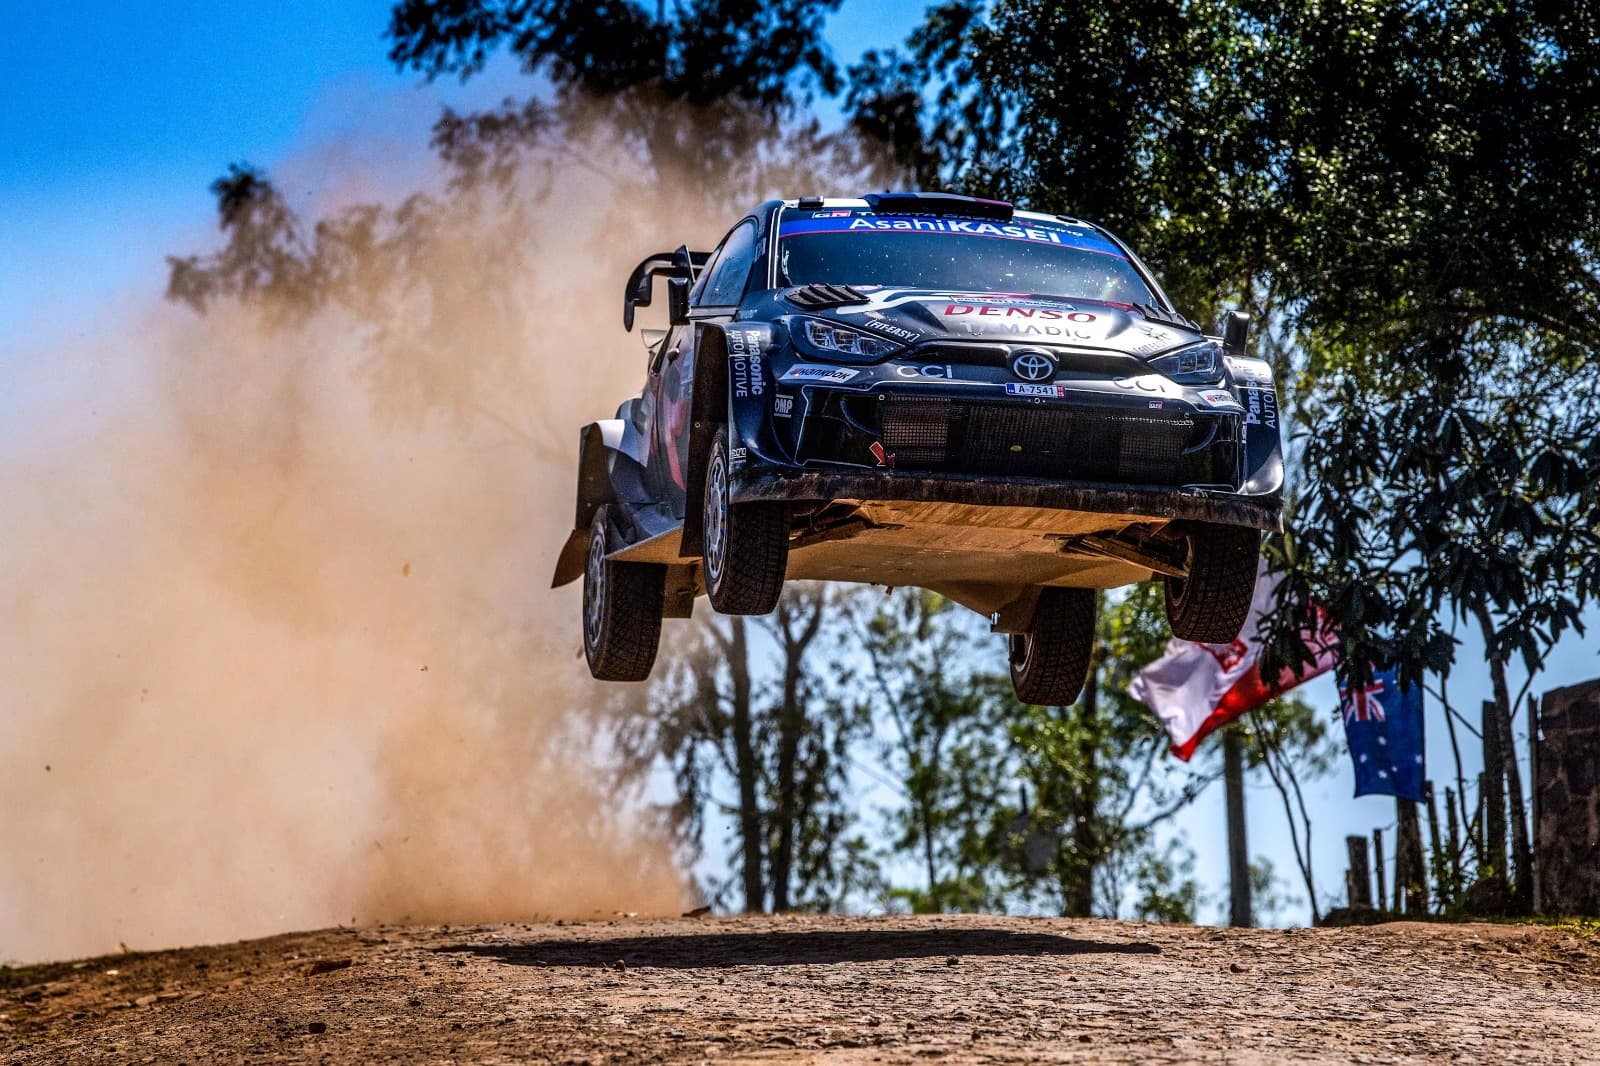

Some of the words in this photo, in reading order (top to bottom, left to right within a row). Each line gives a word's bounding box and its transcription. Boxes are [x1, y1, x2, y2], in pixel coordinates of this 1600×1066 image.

[944, 304, 1097, 323] DENSO
[730, 329, 748, 398] AUTOMOTIVE
[746, 330, 764, 396] Panasonic
[897, 364, 953, 379] CCI
[774, 399, 793, 414] OMP
